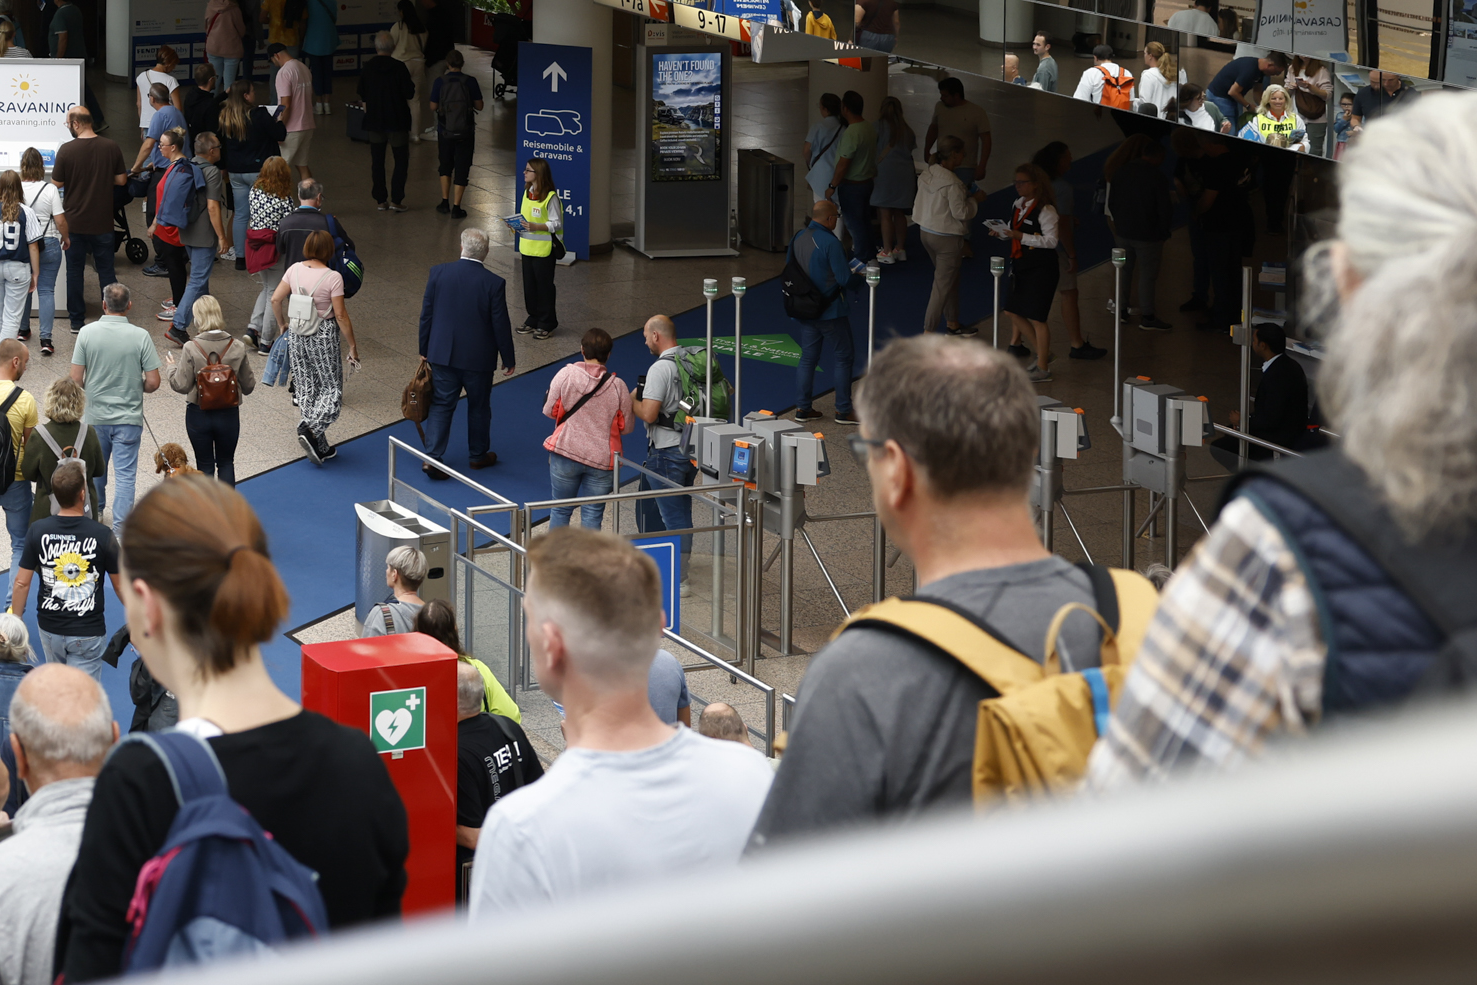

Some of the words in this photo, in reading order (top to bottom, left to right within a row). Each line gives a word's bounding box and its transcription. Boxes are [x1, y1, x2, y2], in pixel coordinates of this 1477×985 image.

[658, 60, 689, 71] HAVEN'T
[690, 60, 715, 71] FOUND
[659, 71, 673, 82] THE
[673, 71, 693, 82] ONE?
[523, 139, 575, 153] Reisemobile
[576, 145, 584, 153] &
[533, 150, 573, 161] Caravans
[712, 344, 764, 357] HALE
[38, 533, 82, 565] Soaking
[41, 596, 61, 611] The
